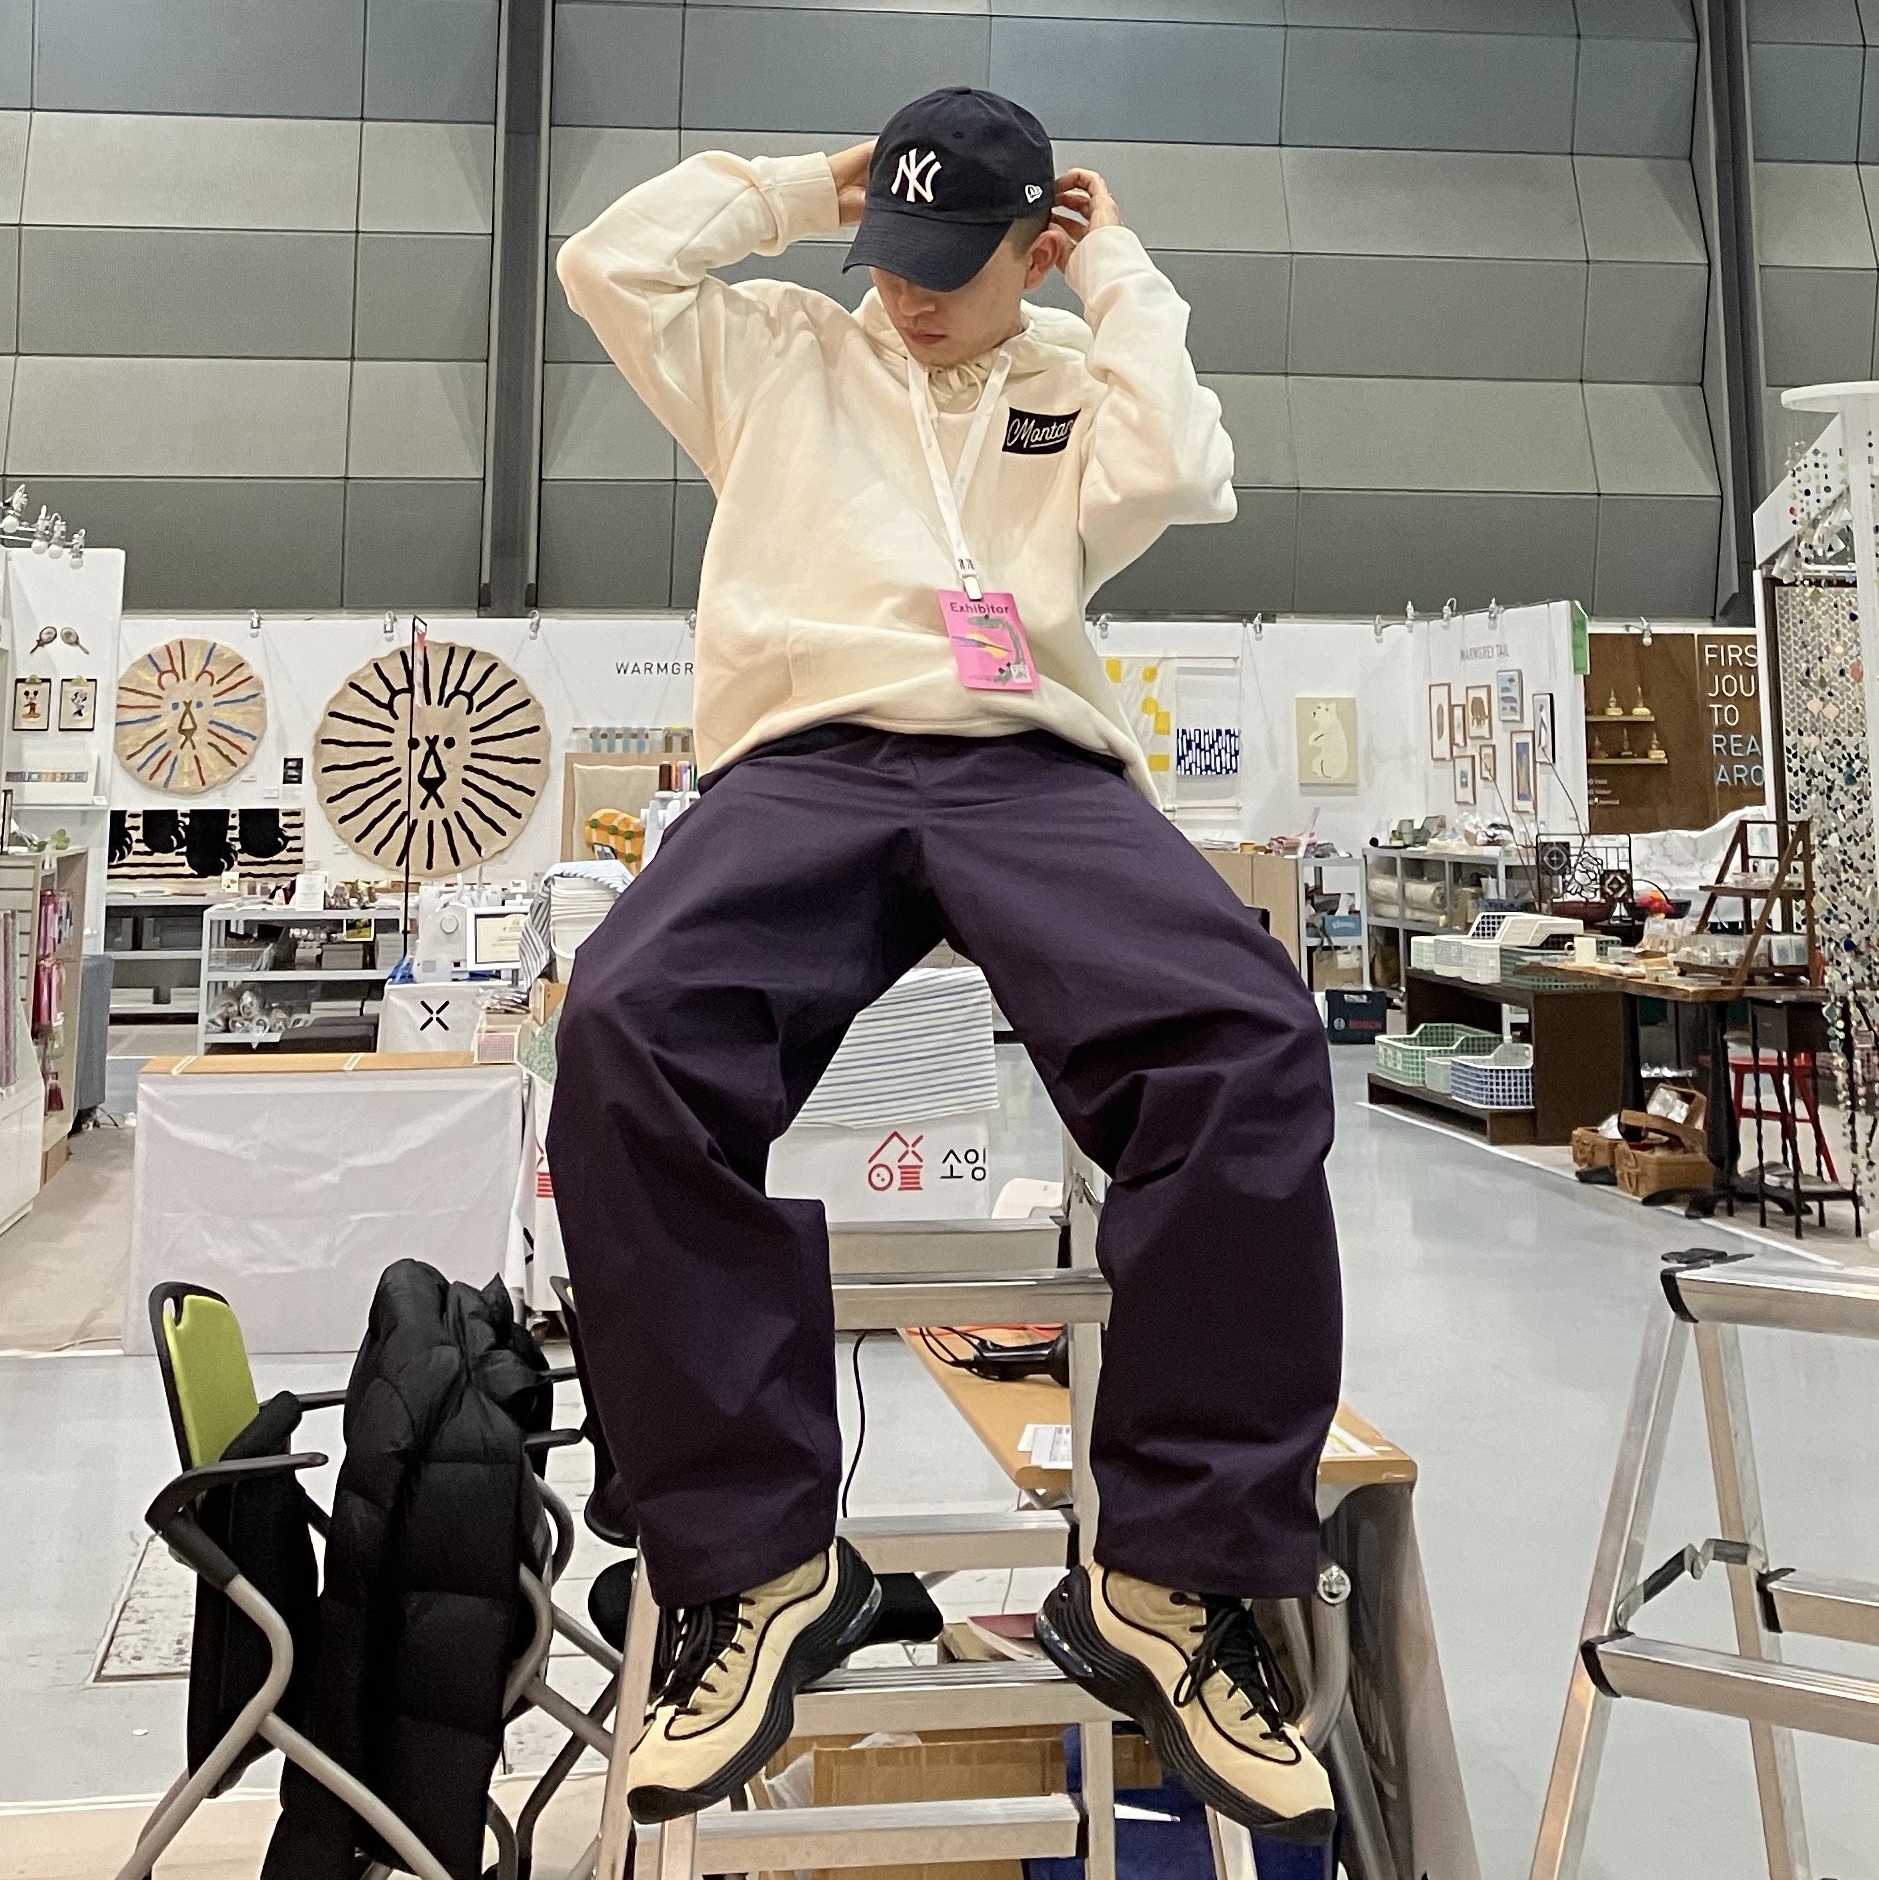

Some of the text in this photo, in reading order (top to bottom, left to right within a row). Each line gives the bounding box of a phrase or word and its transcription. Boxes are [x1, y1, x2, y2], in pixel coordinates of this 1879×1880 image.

[950, 601, 1009, 614] Exhibitor
[1704, 644, 1758, 668] FIRS
[615, 661, 694, 675] WARMGR
[1708, 674, 1755, 697] JOU
[1709, 704, 1739, 726] TO
[1712, 734, 1762, 757] REA
[940, 1147, 986, 1181] 소잉
